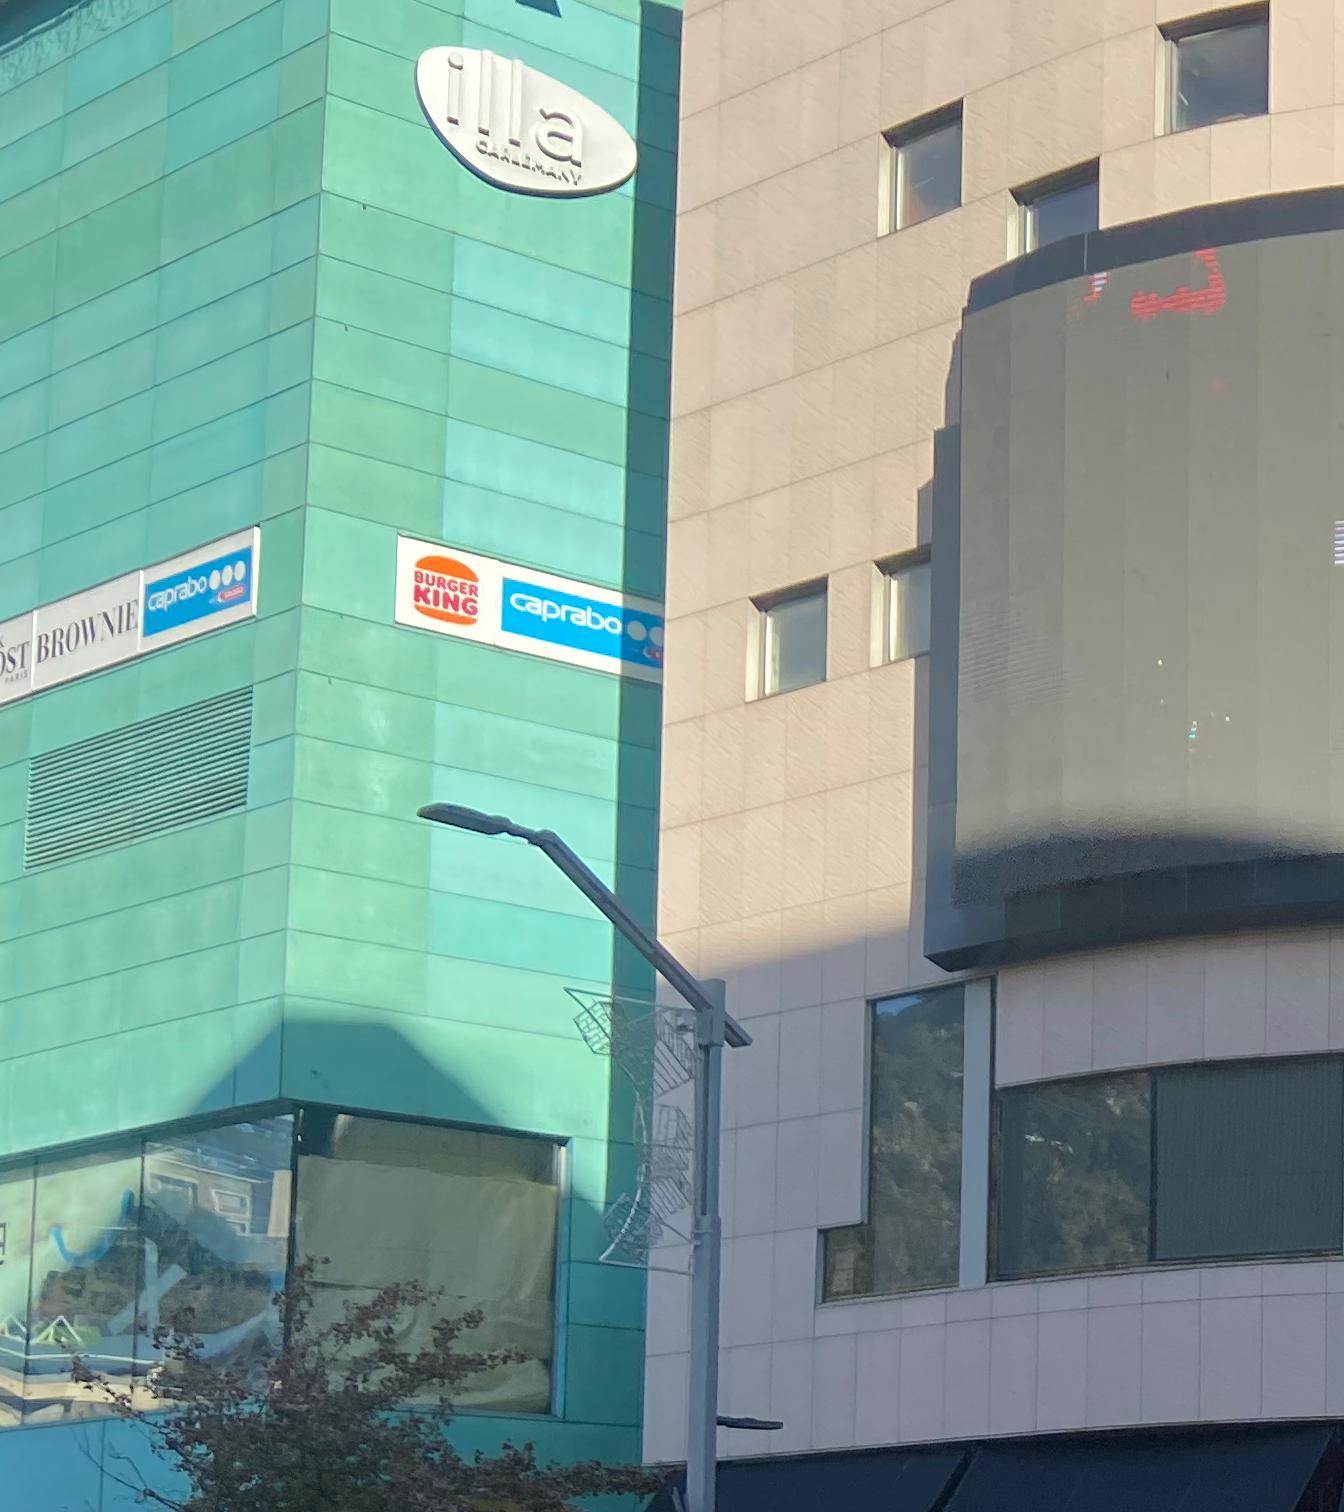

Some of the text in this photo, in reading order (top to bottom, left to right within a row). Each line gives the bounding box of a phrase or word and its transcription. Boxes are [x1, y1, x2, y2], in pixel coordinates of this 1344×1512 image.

[446, 50, 583, 168] illa
[148, 575, 208, 613] caprabo
[413, 569, 479, 598] BURGER
[413, 584, 479, 617] KING
[37, 599, 139, 664] BROWNIE
[509, 592, 623, 635] caprabo
